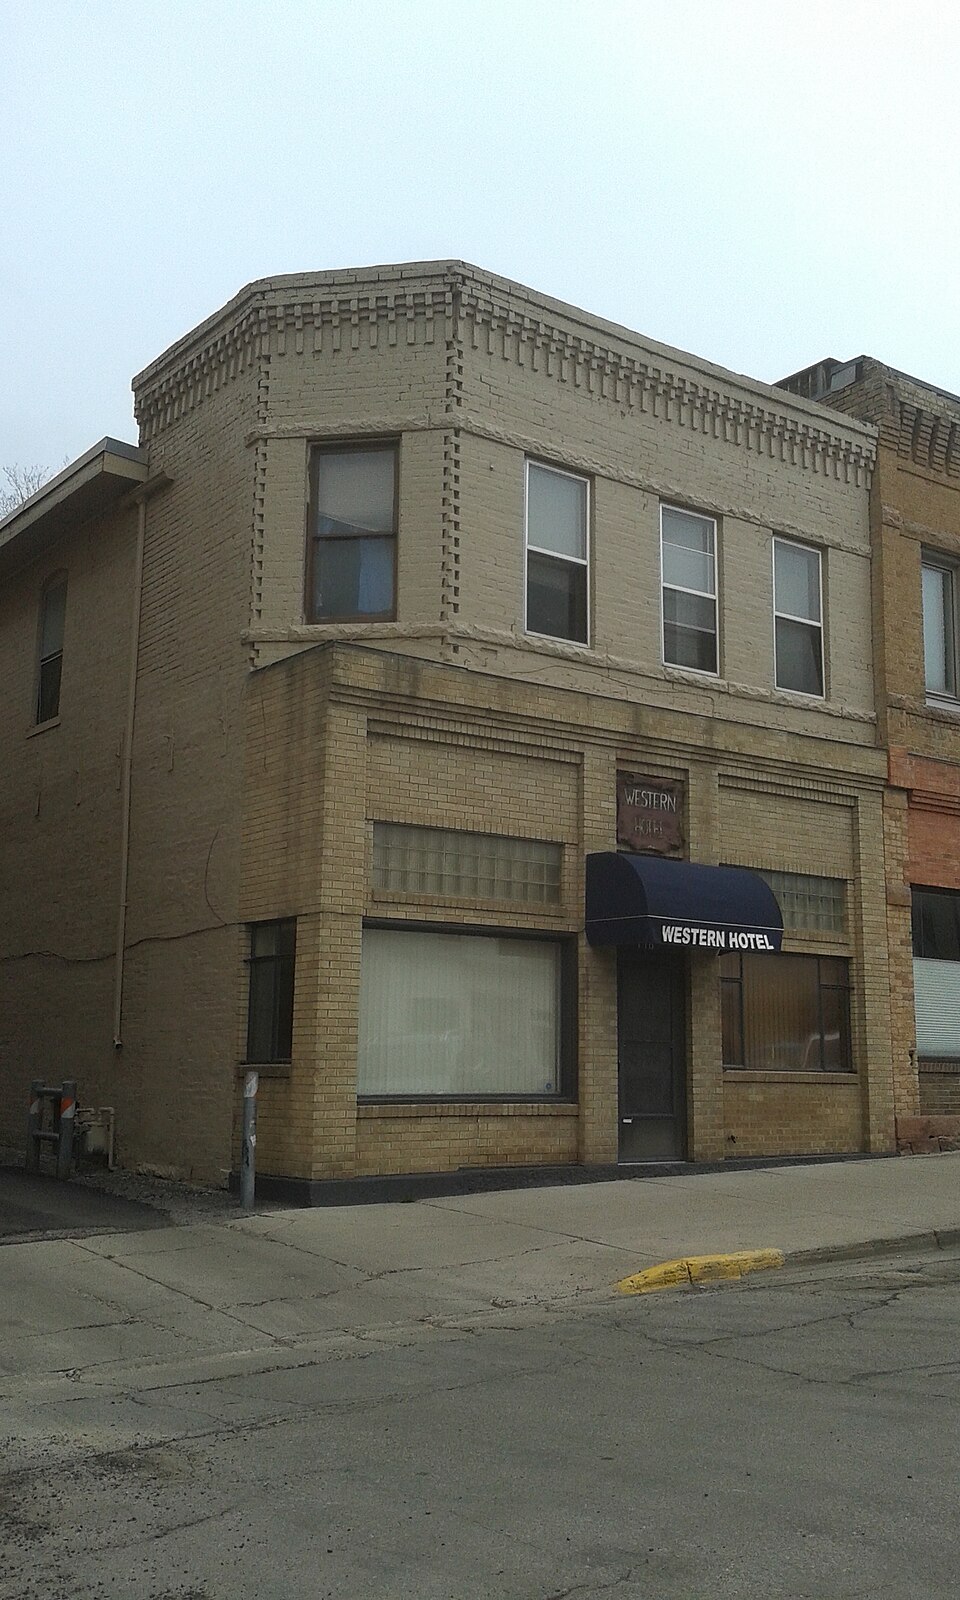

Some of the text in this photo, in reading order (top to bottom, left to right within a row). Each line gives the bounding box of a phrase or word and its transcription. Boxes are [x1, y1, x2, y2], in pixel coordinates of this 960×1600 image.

[624, 788, 677, 813] WESTERN
[662, 925, 775, 950] WESTERN HOTEL
